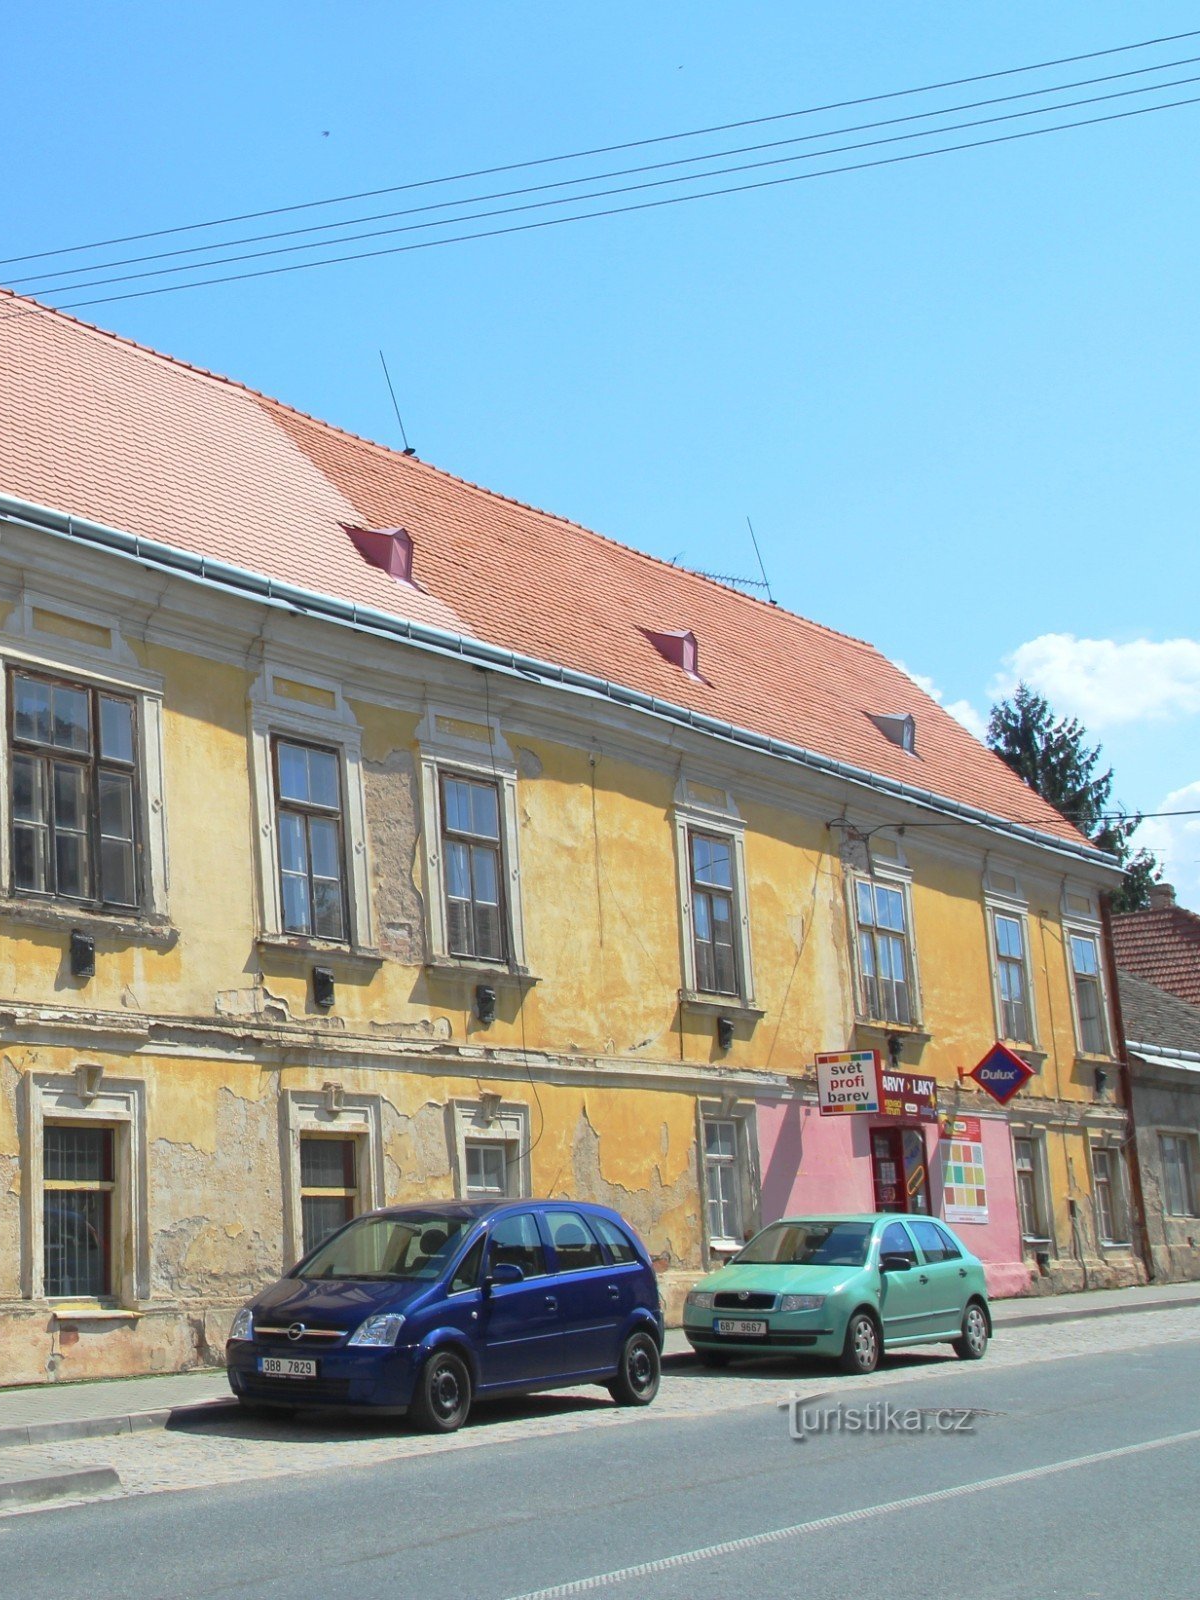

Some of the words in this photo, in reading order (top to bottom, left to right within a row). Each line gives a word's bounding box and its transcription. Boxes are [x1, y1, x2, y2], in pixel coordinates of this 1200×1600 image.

[831, 1061, 862, 1076] svět
[830, 1075, 865, 1091] profi
[882, 1075, 905, 1093] ARVY
[912, 1079, 934, 1096] LAKY
[828, 1091, 869, 1103] barev
[720, 1321, 735, 1332] 6B7
[740, 1322, 762, 1333] 9667
[264, 1359, 281, 1373] 3B8
[288, 1360, 312, 1374] 7829
